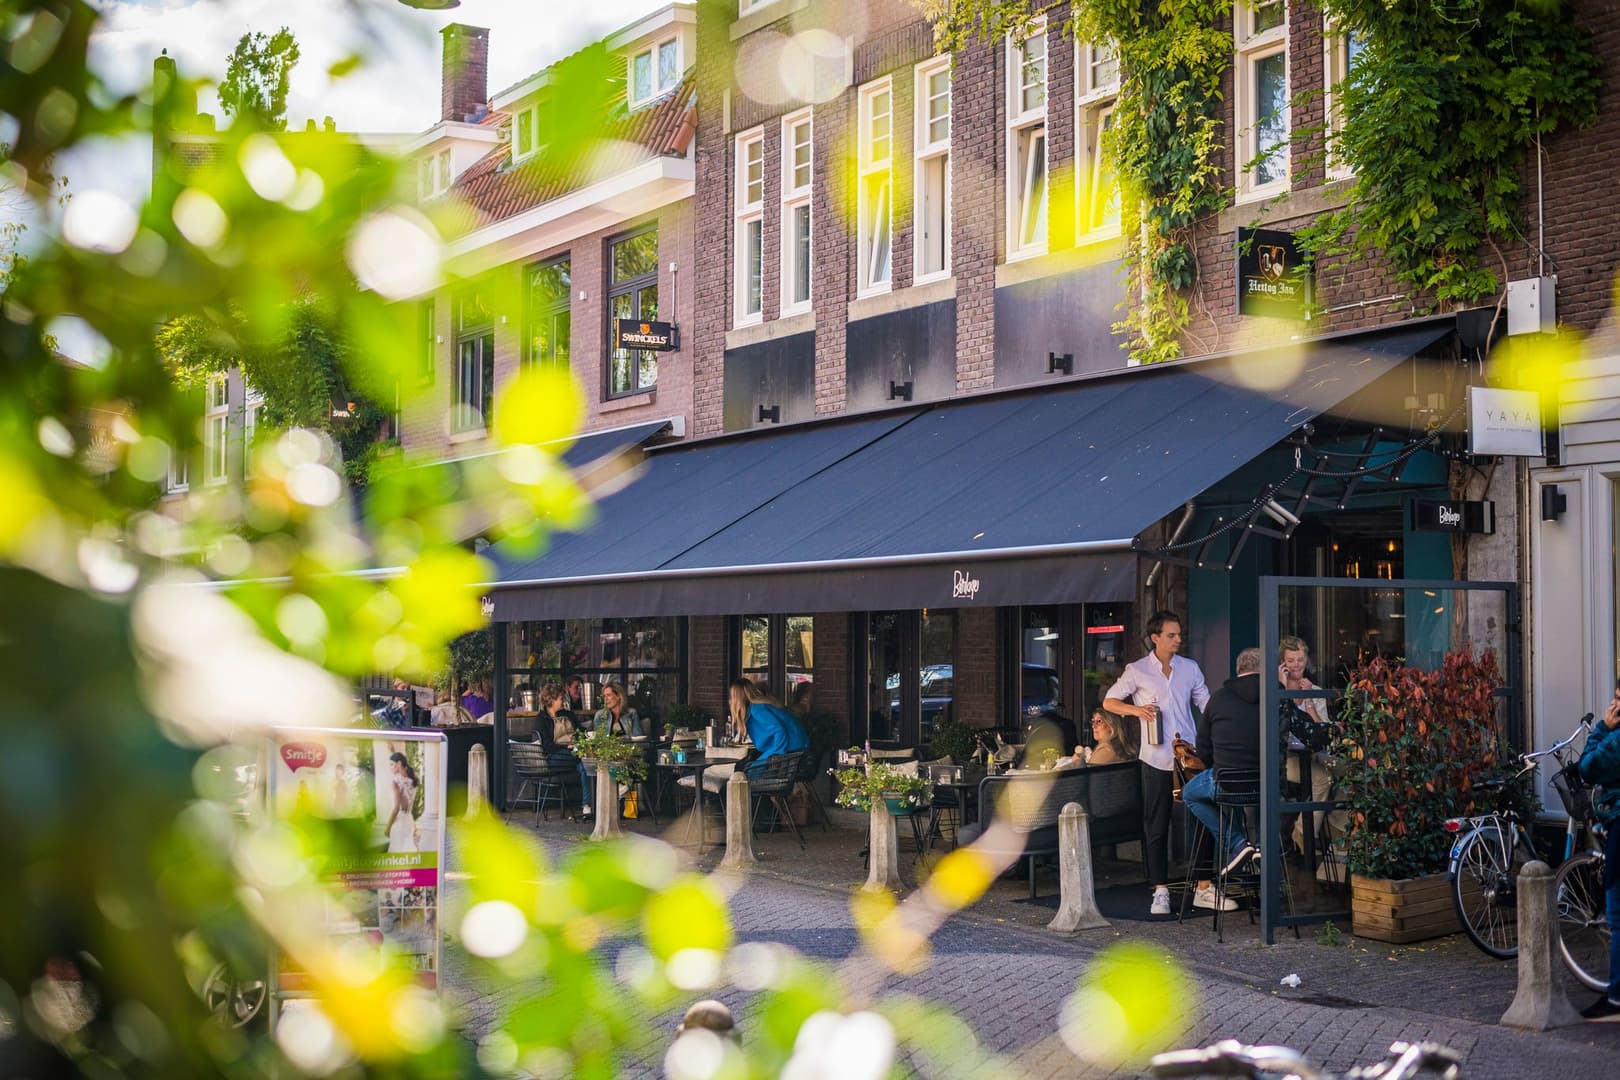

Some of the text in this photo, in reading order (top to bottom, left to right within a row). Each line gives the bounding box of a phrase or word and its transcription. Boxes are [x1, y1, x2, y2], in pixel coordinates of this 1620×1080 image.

[1248, 279, 1295, 296] Hertog Jan
[1486, 409, 1532, 423] YAYA
[285, 748, 322, 763] Smitje
